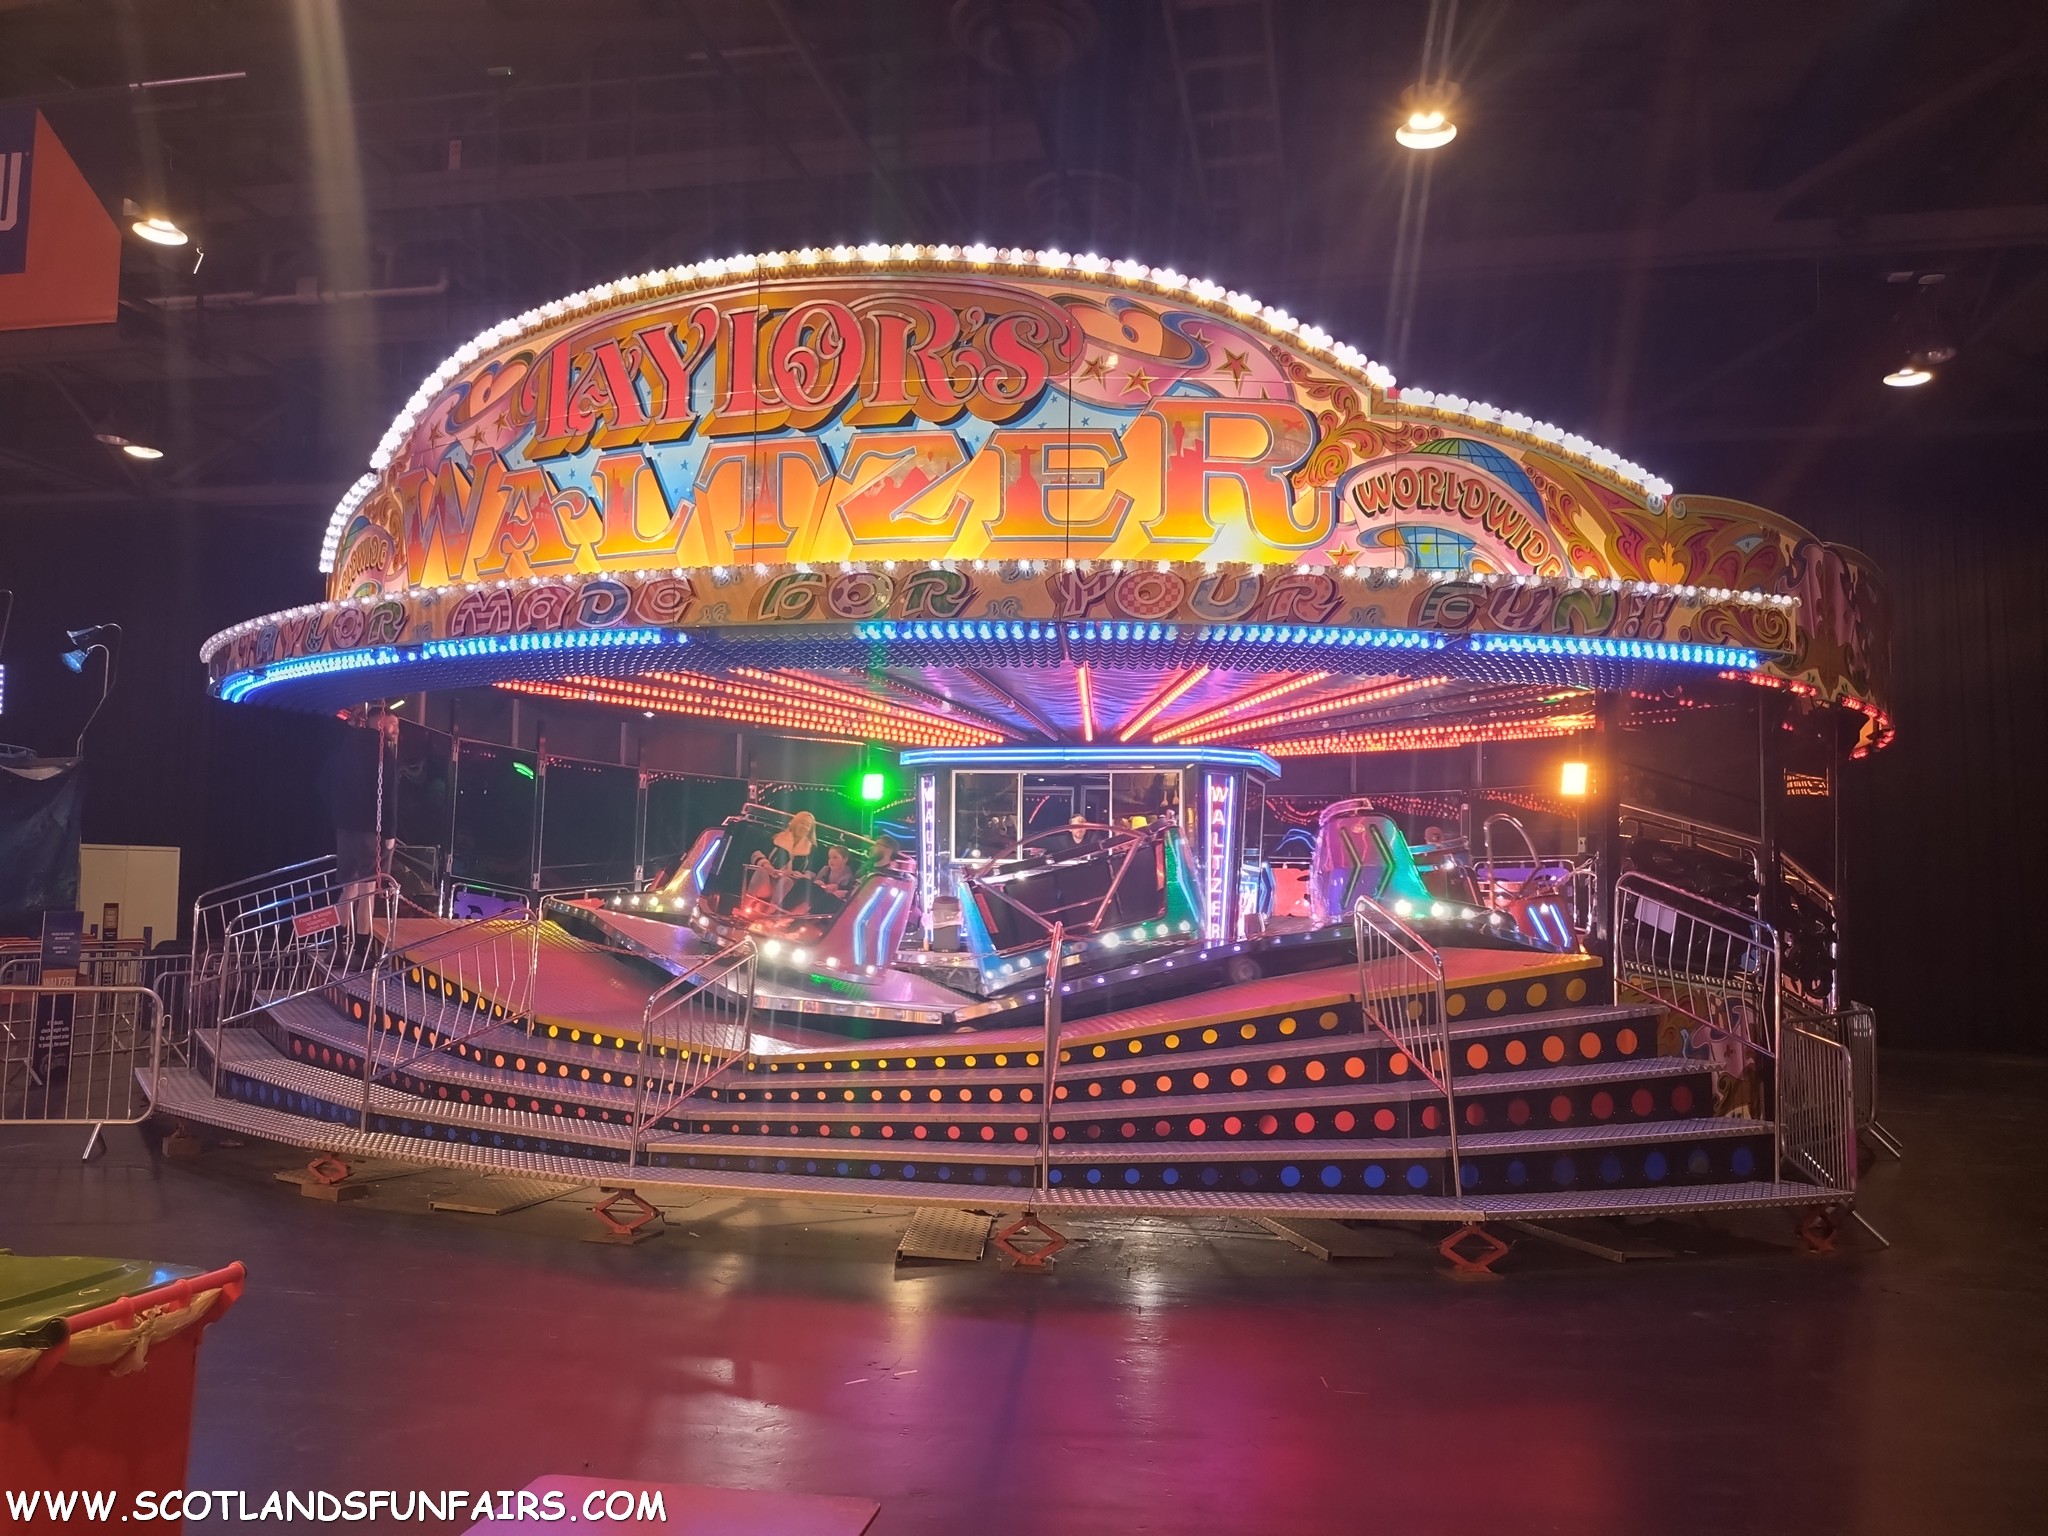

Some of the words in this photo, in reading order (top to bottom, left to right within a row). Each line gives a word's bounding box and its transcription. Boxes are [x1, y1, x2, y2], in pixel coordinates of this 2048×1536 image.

[521, 293, 1083, 443] TAYLOR'S
[400, 397, 1336, 588] WALTZER
[240, 600, 410, 662] TAYLOR
[445, 576, 702, 638] MADE
[751, 568, 979, 624] FOR
[1051, 568, 1353, 625] YOUR
[1408, 581, 1679, 641] FUN!!
[1210, 785, 1229, 939] WALTZER
